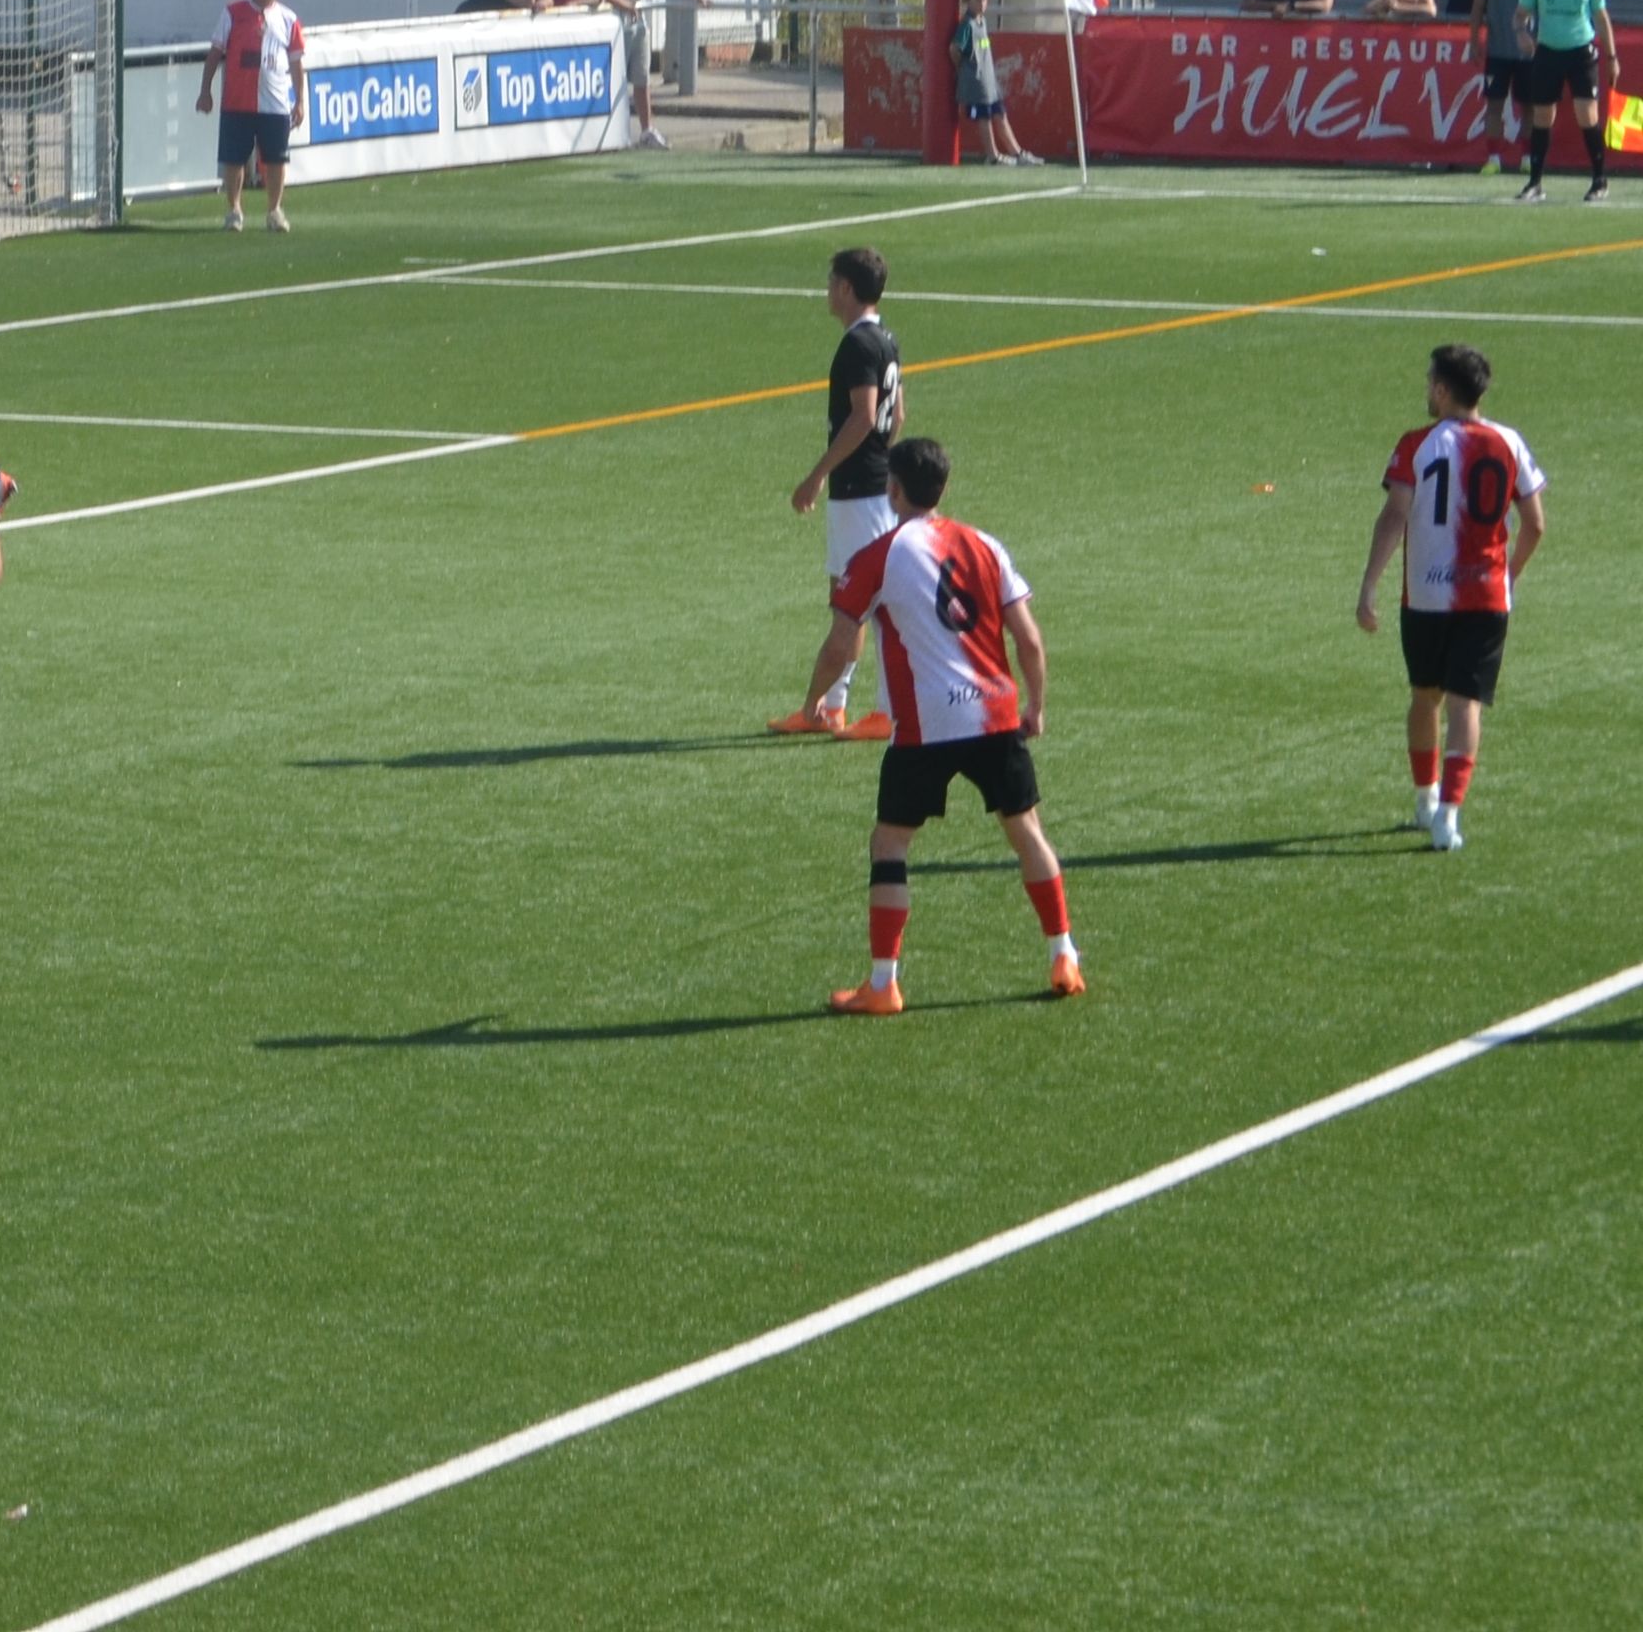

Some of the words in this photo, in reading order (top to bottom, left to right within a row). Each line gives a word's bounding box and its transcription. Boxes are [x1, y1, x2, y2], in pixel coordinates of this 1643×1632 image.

[1171, 33, 1237, 57] BAR
[315, 82, 358, 134] Top
[361, 73, 433, 119] Cable
[497, 66, 535, 116] Top
[541, 58, 605, 103] Cable
[1422, 457, 1508, 526] 10
[935, 557, 979, 634] 6
